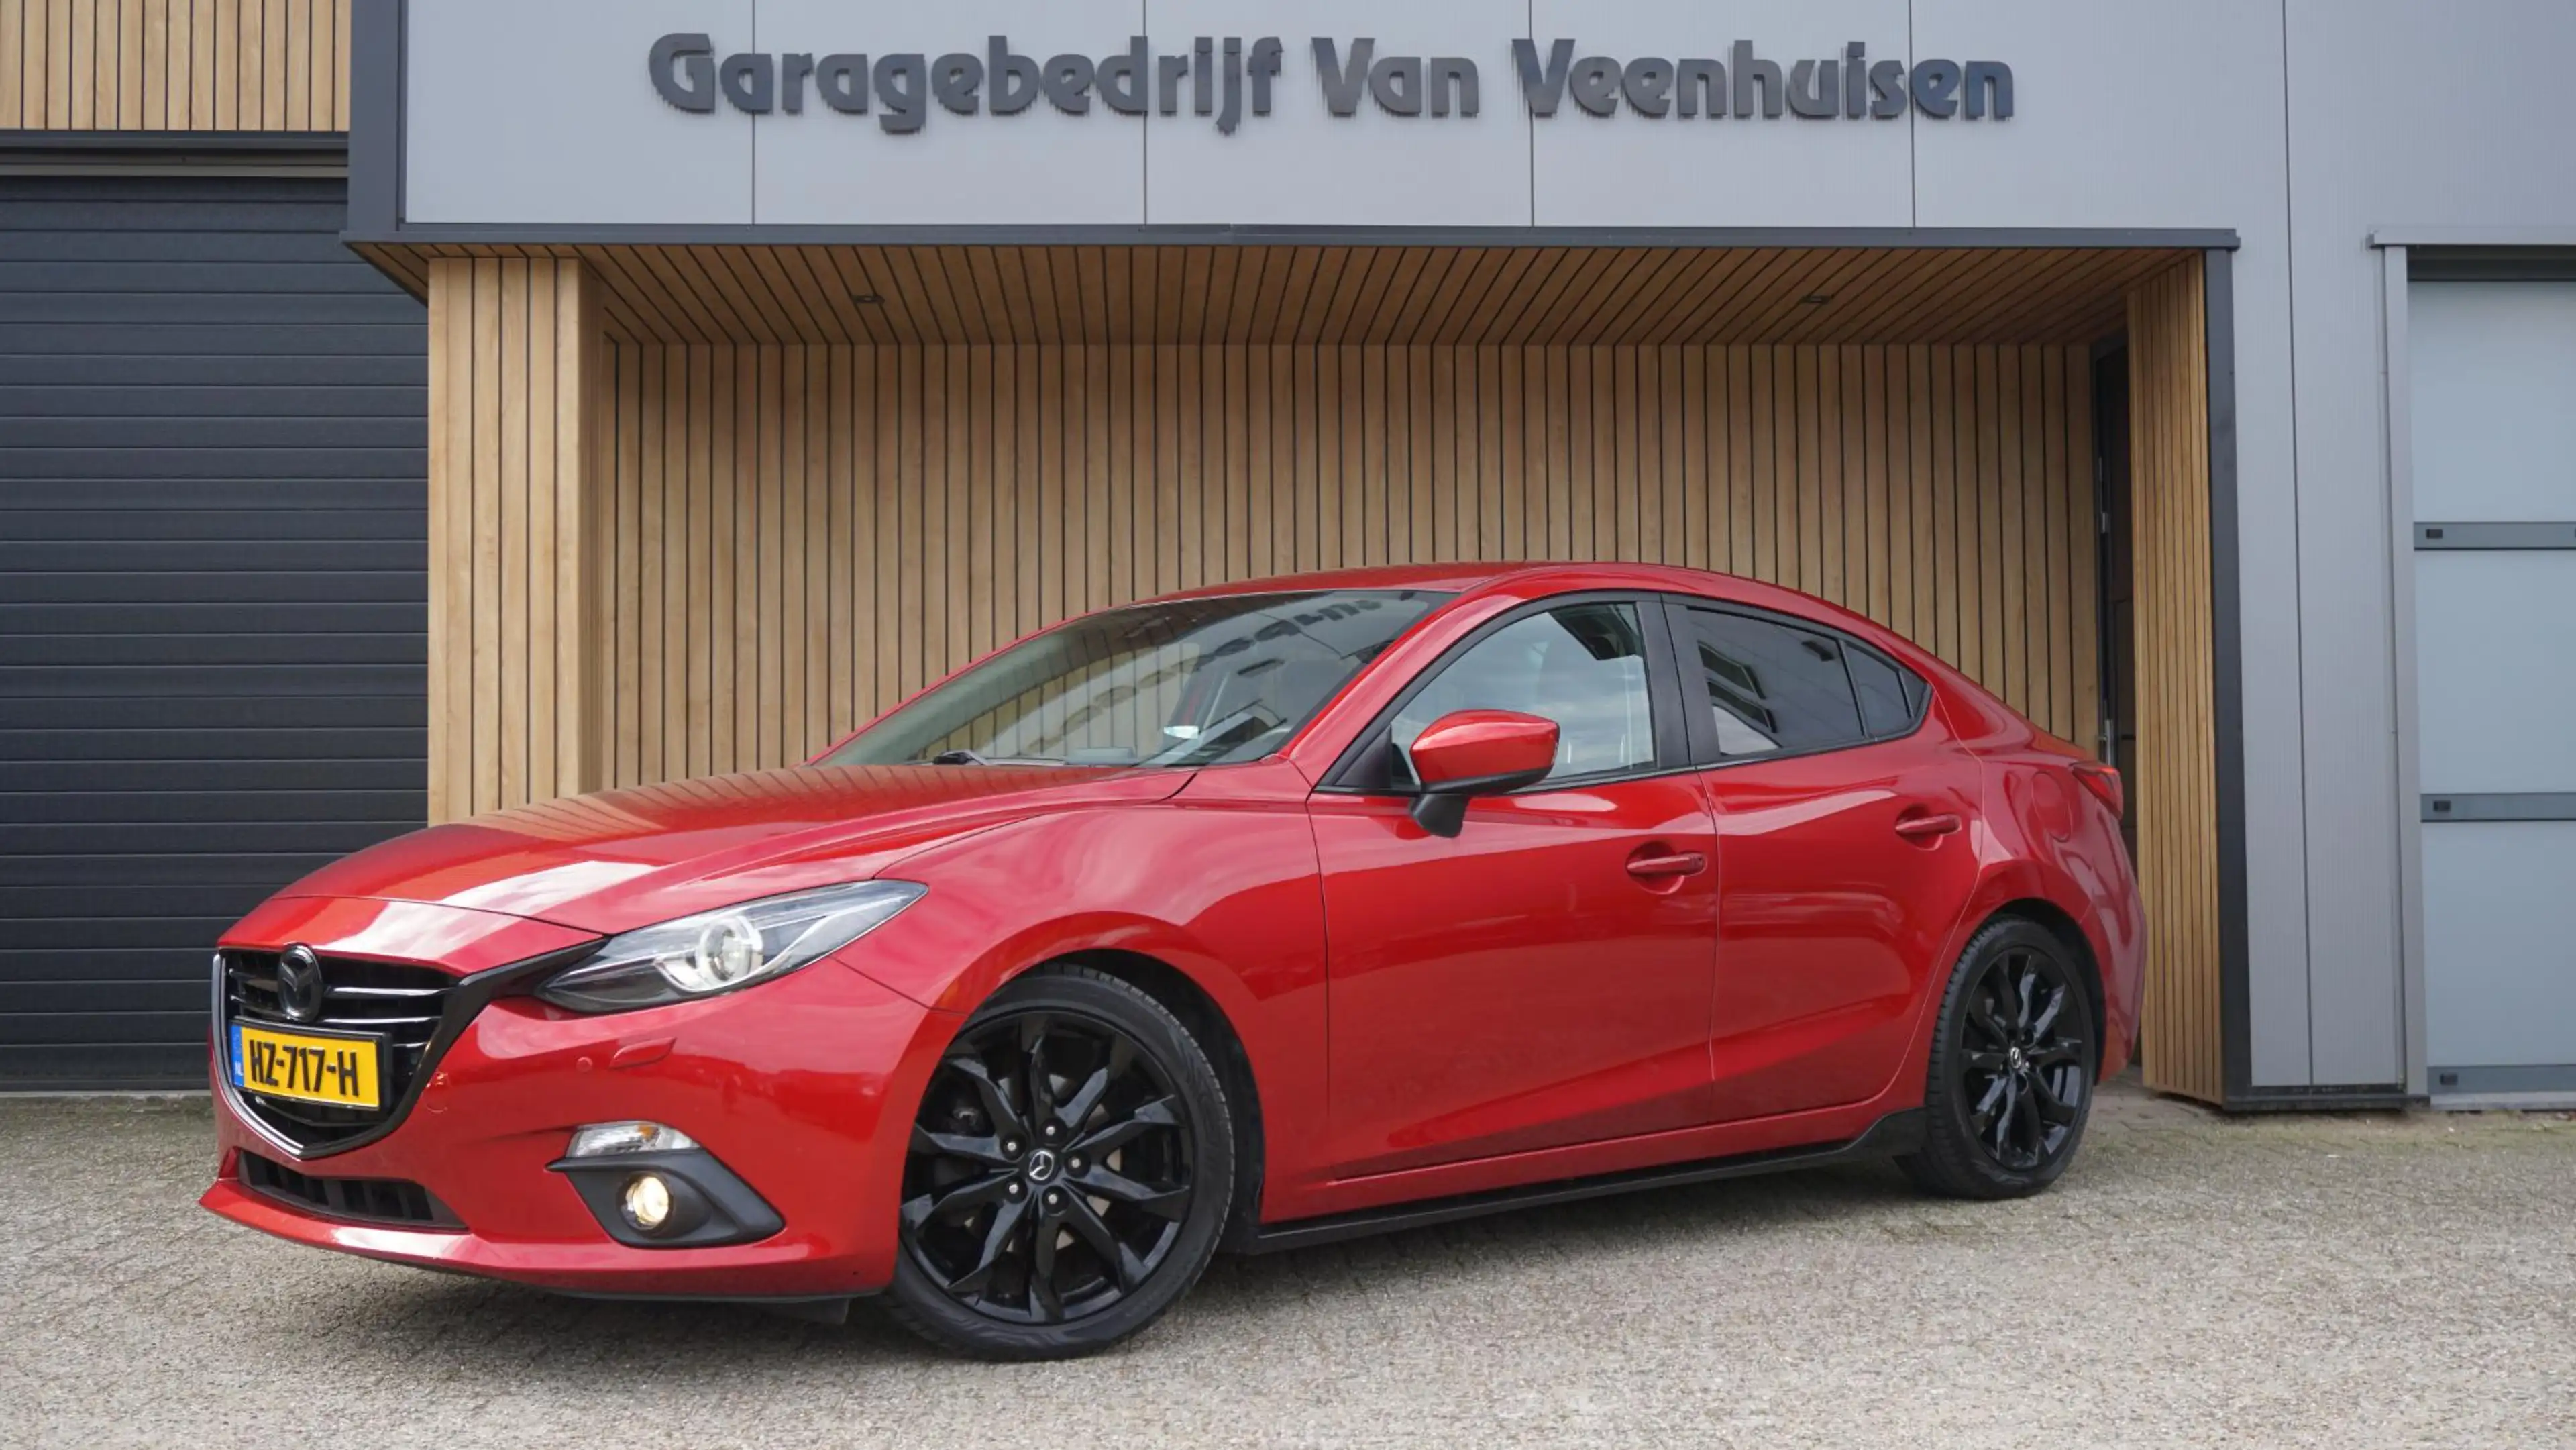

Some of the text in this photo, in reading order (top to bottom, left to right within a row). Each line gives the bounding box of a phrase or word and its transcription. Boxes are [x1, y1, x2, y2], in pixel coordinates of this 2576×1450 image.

[648, 33, 2013, 135] Garagebedrijf Van Veenhuisen
[249, 1039, 359, 1097] HZ-717-H
